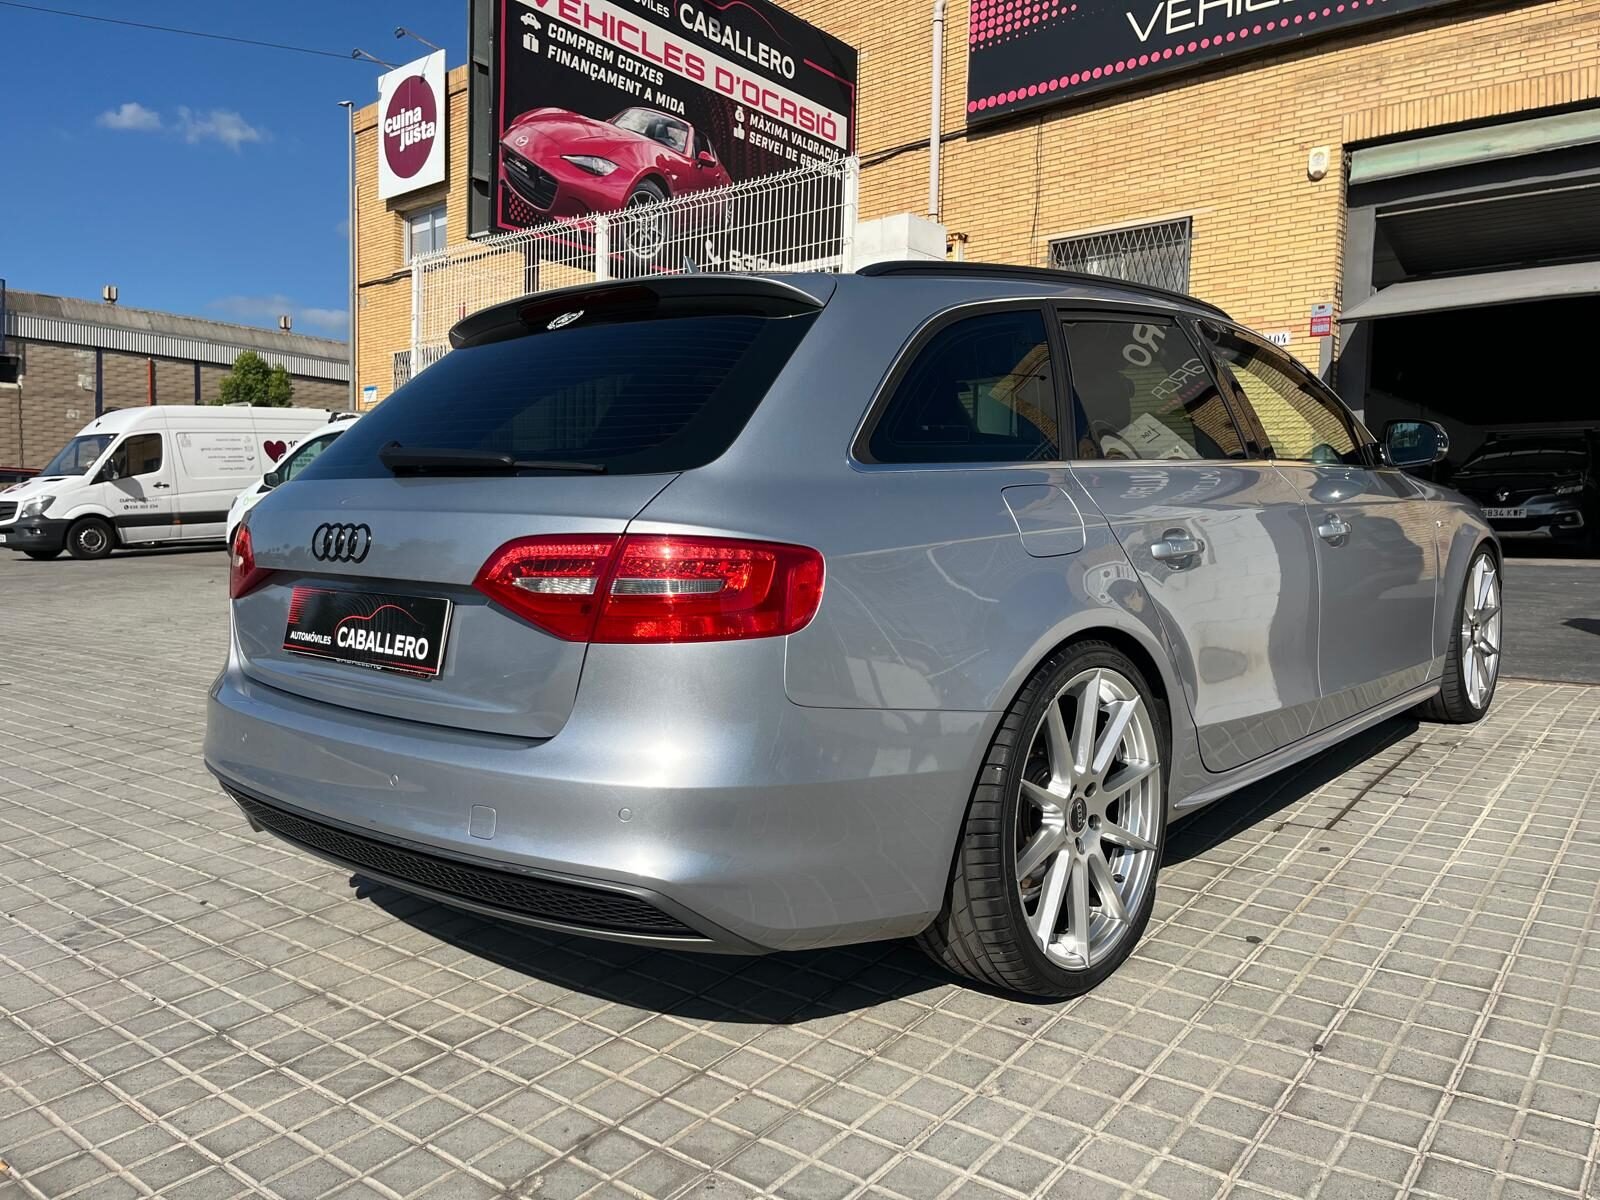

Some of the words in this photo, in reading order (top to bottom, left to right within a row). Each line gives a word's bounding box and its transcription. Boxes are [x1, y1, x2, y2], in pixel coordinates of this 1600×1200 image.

[548, 23, 614, 64] COMPREM
[617, 54, 664, 86] COTXES
[633, 0, 670, 18] VILES
[679, 3, 796, 80] CABALLERO
[547, 45, 643, 97] FINANÇAMENT
[644, 87, 653, 102] A
[655, 91, 685, 116] MIDA
[715, 66, 837, 141] D'OCASIÓ
[384, 106, 422, 134] cuina
[399, 120, 435, 152] justa
[749, 113, 789, 141] MÀXIMA
[791, 131, 840, 161] VALORACIÓ
[749, 132, 783, 156] SERVEI
[785, 146, 798, 162] DE
[290, 630, 332, 645] AUTOMÓVILES
[337, 626, 429, 661] CABALLERO
